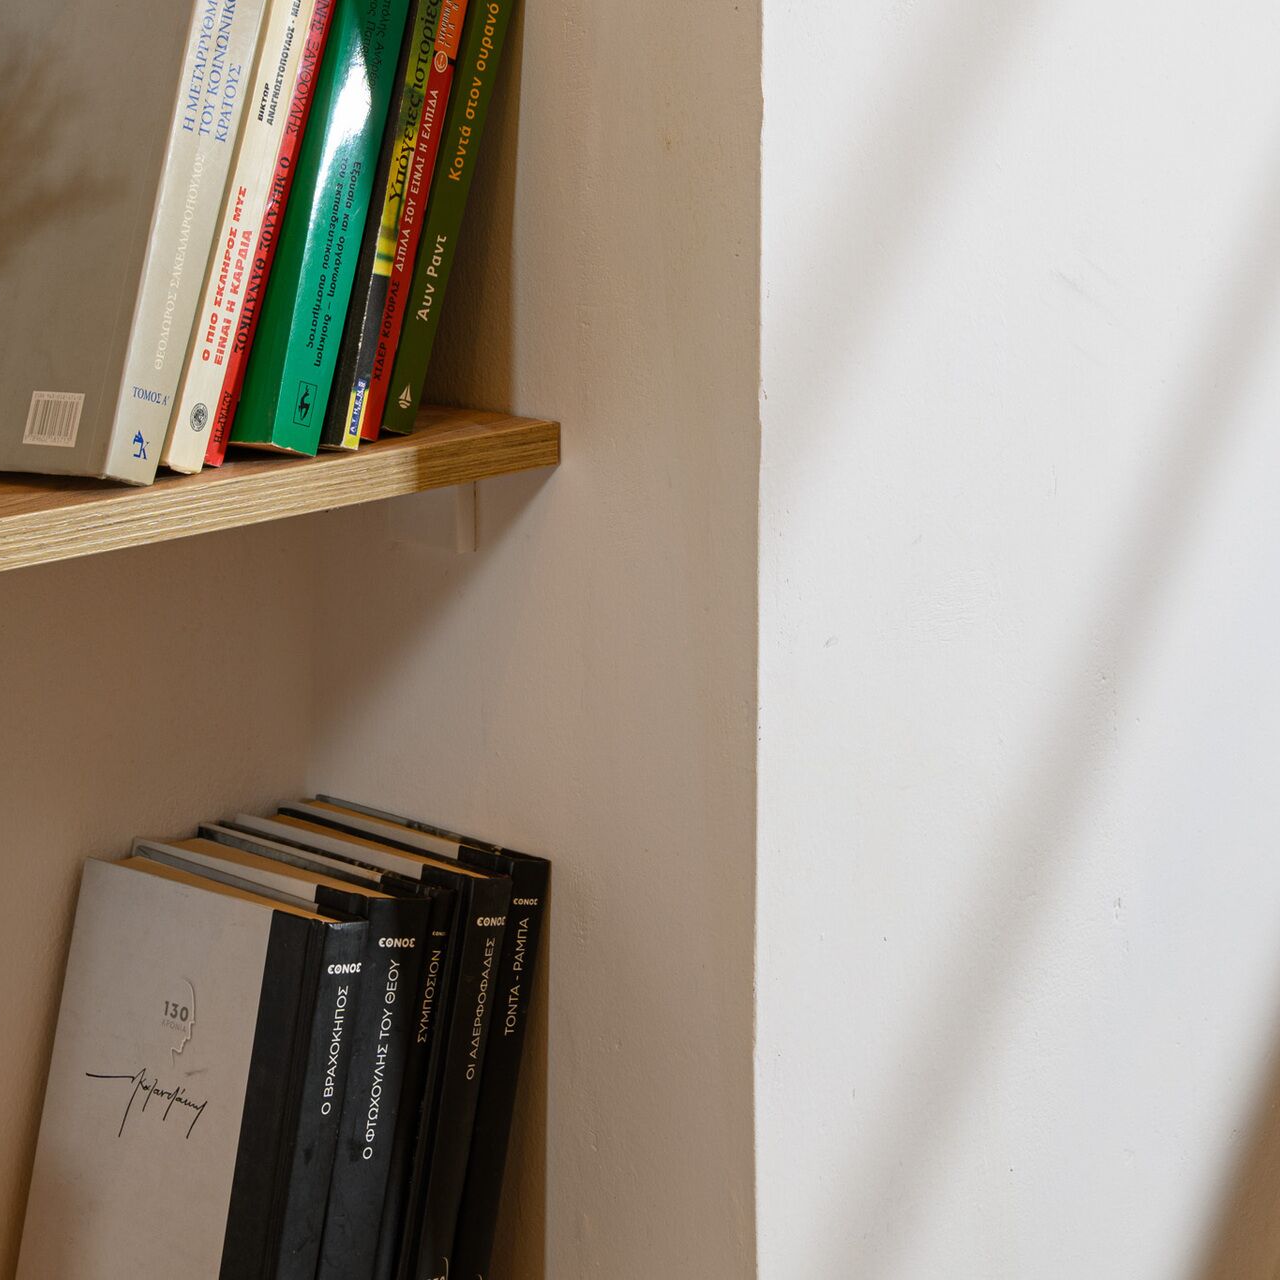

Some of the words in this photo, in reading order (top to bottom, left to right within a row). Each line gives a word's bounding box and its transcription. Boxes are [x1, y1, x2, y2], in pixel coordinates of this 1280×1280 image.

[266, 26, 296, 126] ΑΝΑΓΝΩΣΤΟΠΟΥΛΟΣ
[285, 38, 320, 138] ΞΑΝΘΟΥΛΗΣ
[447, 126, 472, 182] Κοντά
[465, 77, 483, 120] στον
[476, 2, 501, 71] ουρανό
[183, 118, 196, 133] Η
[199, 100, 215, 137] ΤΟΥ
[215, 63, 242, 143] ΚΡΑΤΟΥΣ
[258, 82, 270, 122] ΒΙΚΤΩΡ
[421, 89, 439, 140] ΕΛΠΙΔΑ
[279, 156, 290, 169] Ο
[389, 94, 424, 203] Υπόγειες
[418, 143, 428, 153] Η
[345, 161, 361, 210] Εξουσία
[411, 157, 426, 195] ΕΙΝΑΙ
[259, 174, 287, 253] ΜΕΓΑΛΟΣ
[323, 182, 345, 270] εκπαιδευτικού
[343, 212, 351, 231] και
[404, 196, 416, 224] ΣΟΥ
[202, 349, 210, 361] Ο
[208, 312, 219, 344] ΠΙΟ
[214, 226, 238, 308] ΣΚΛΗΡΟΣ
[233, 186, 247, 223] ΜΥΣ
[230, 230, 253, 295] ΚΑΡΔΙΑ
[329, 233, 347, 298] οργάνωση
[394, 229, 411, 272] ΔΙΠΛΑ
[415, 283, 435, 322] Άυν
[427, 233, 447, 278] Ραντ
[226, 301, 236, 313] Η
[234, 257, 266, 354] ΘΑΝΑΤΙΚΟΣ
[306, 273, 327, 349] συστήματος
[154, 292, 177, 370] ΘΕΟΔΩΡΟΣ
[214, 318, 232, 366] ΕΙΝΑΙ
[314, 314, 331, 368] διοίκηση
[132, 385, 163, 406] ΤΟΜΟΣ
[378, 937, 416, 948] ΕΘΝΟΣ
[327, 962, 362, 974] ΕΘΝΟΣ
[384, 959, 401, 1005] ΘΕΟΥ
[504, 984, 521, 1036] ΤΟΝΤΑ
[513, 917, 531, 972] ΡΑΜΠΑ
[164, 1001, 189, 1022] 130
[417, 950, 442, 1044] ΣΥΜΠΟΣΙΟΝ
[469, 937, 496, 1059] ΑΔΕΡΦΟΦΑΔΕΣ
[323, 985, 350, 1098] ΒΡΑΧΟΚΗΠΟΣ
[379, 1008, 393, 1040] ΤΟΥ
[365, 1043, 389, 1143] ΦΤΩΧΟΥΛΗΣ
[466, 1063, 476, 1080] ΟΙ
[321, 1102, 332, 1116] Ο
[362, 1147, 373, 1160] Ο
